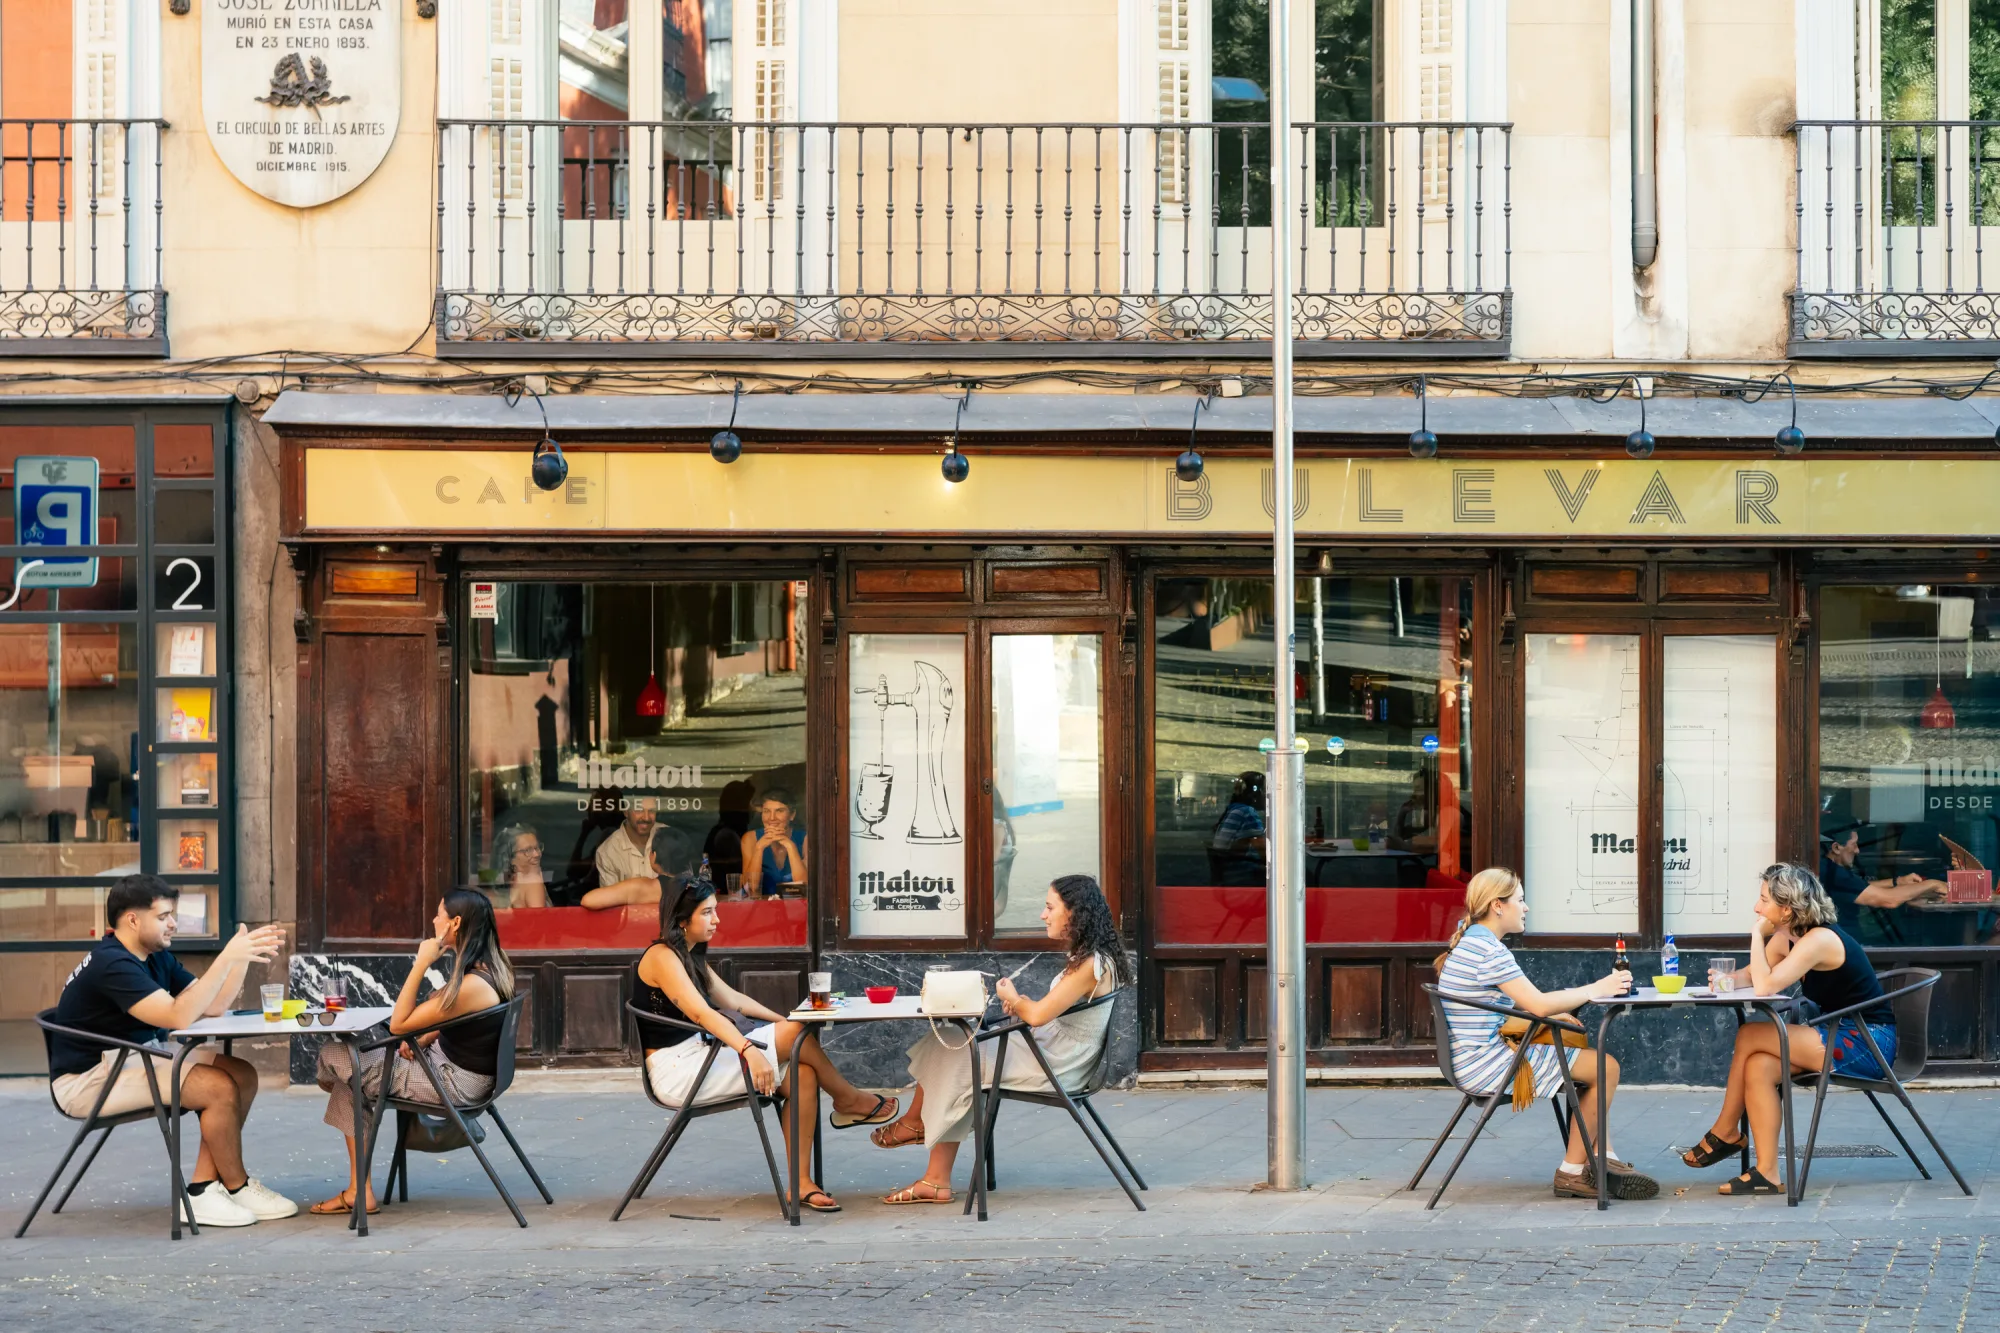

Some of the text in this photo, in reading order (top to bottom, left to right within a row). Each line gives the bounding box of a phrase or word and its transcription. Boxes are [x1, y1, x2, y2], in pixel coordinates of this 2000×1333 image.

[227, 14, 374, 30] MURIÓ EN ESTA CASA
[235, 36, 370, 49] EN 23 ENERO 1893.
[216, 121, 385, 136] EL CIRCULO DE BELLAS ARTES
[268, 142, 284, 155] DE
[256, 161, 317, 172] DICIEMBRE
[1165, 468, 1782, 523] BULEVAR
[165, 557, 203, 611] 2
[577, 756, 704, 789] Mahou
[577, 798, 703, 811] DESDE 1890
[1929, 796, 1993, 809] DESDE
[1590, 832, 1689, 854] Mau
[1662, 858, 1691, 871] drid
[857, 869, 956, 895] Mahou
